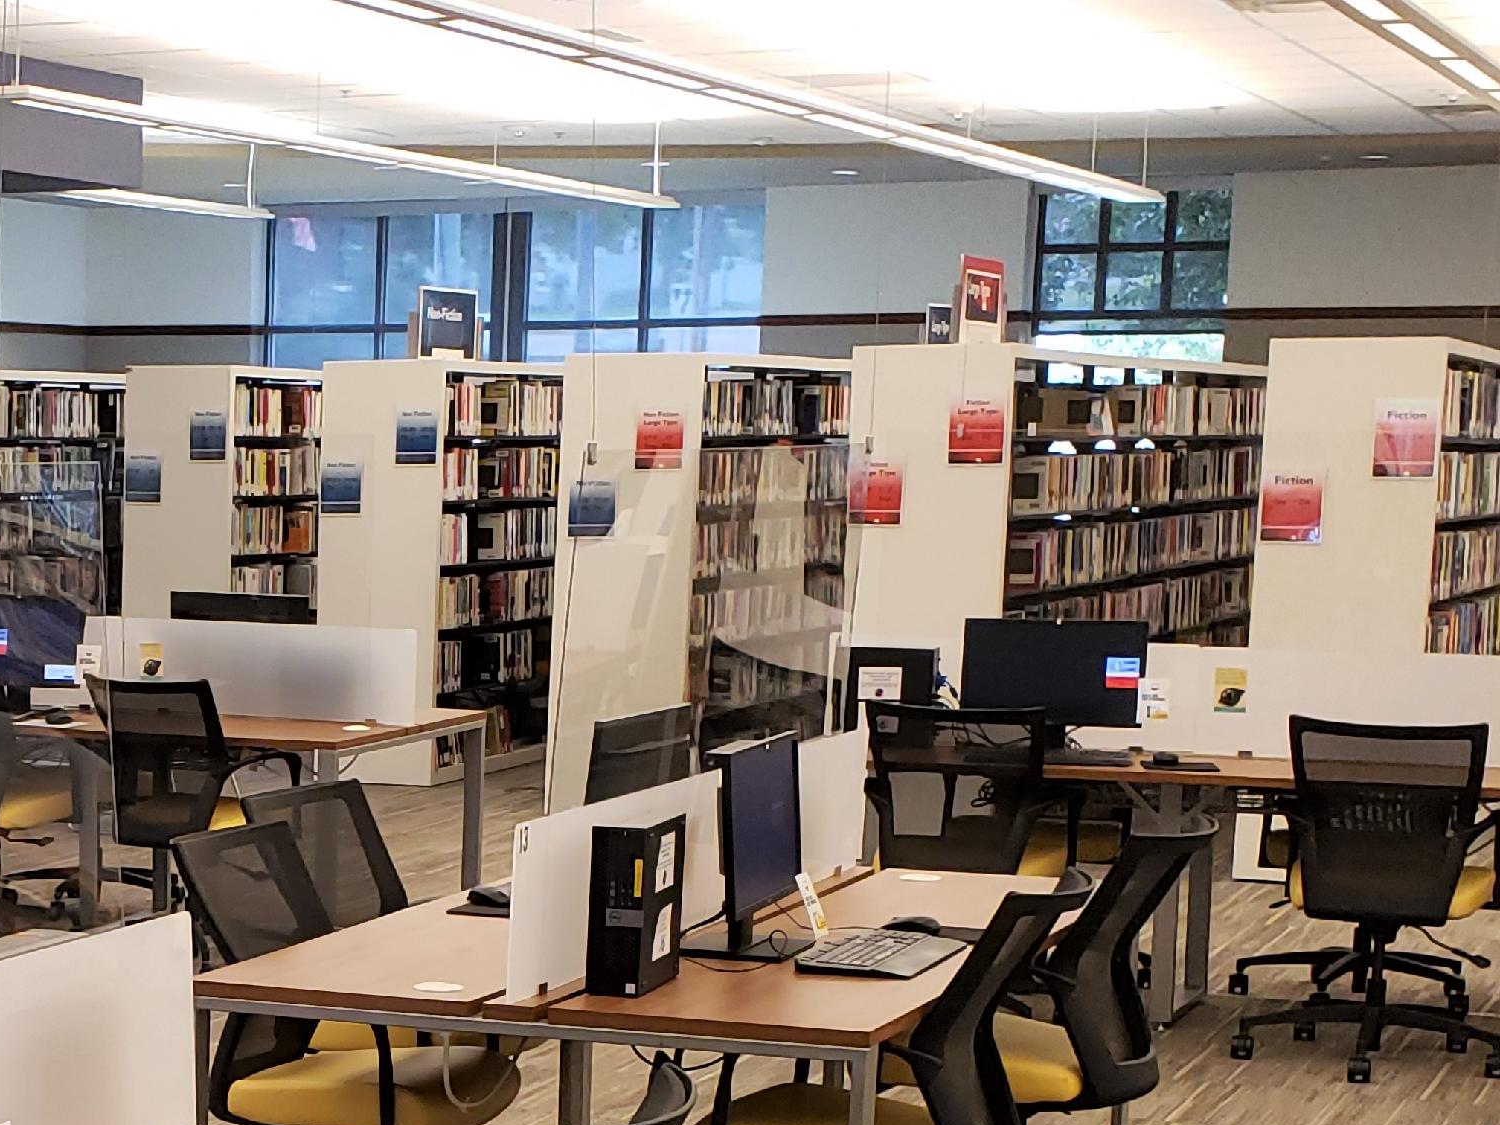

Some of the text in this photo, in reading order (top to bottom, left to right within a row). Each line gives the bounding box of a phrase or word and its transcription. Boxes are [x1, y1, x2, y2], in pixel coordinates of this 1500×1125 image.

[1387, 410, 1428, 421] Fiction
[1274, 475, 1314, 486] Fiction
[518, 825, 529, 855] 13
